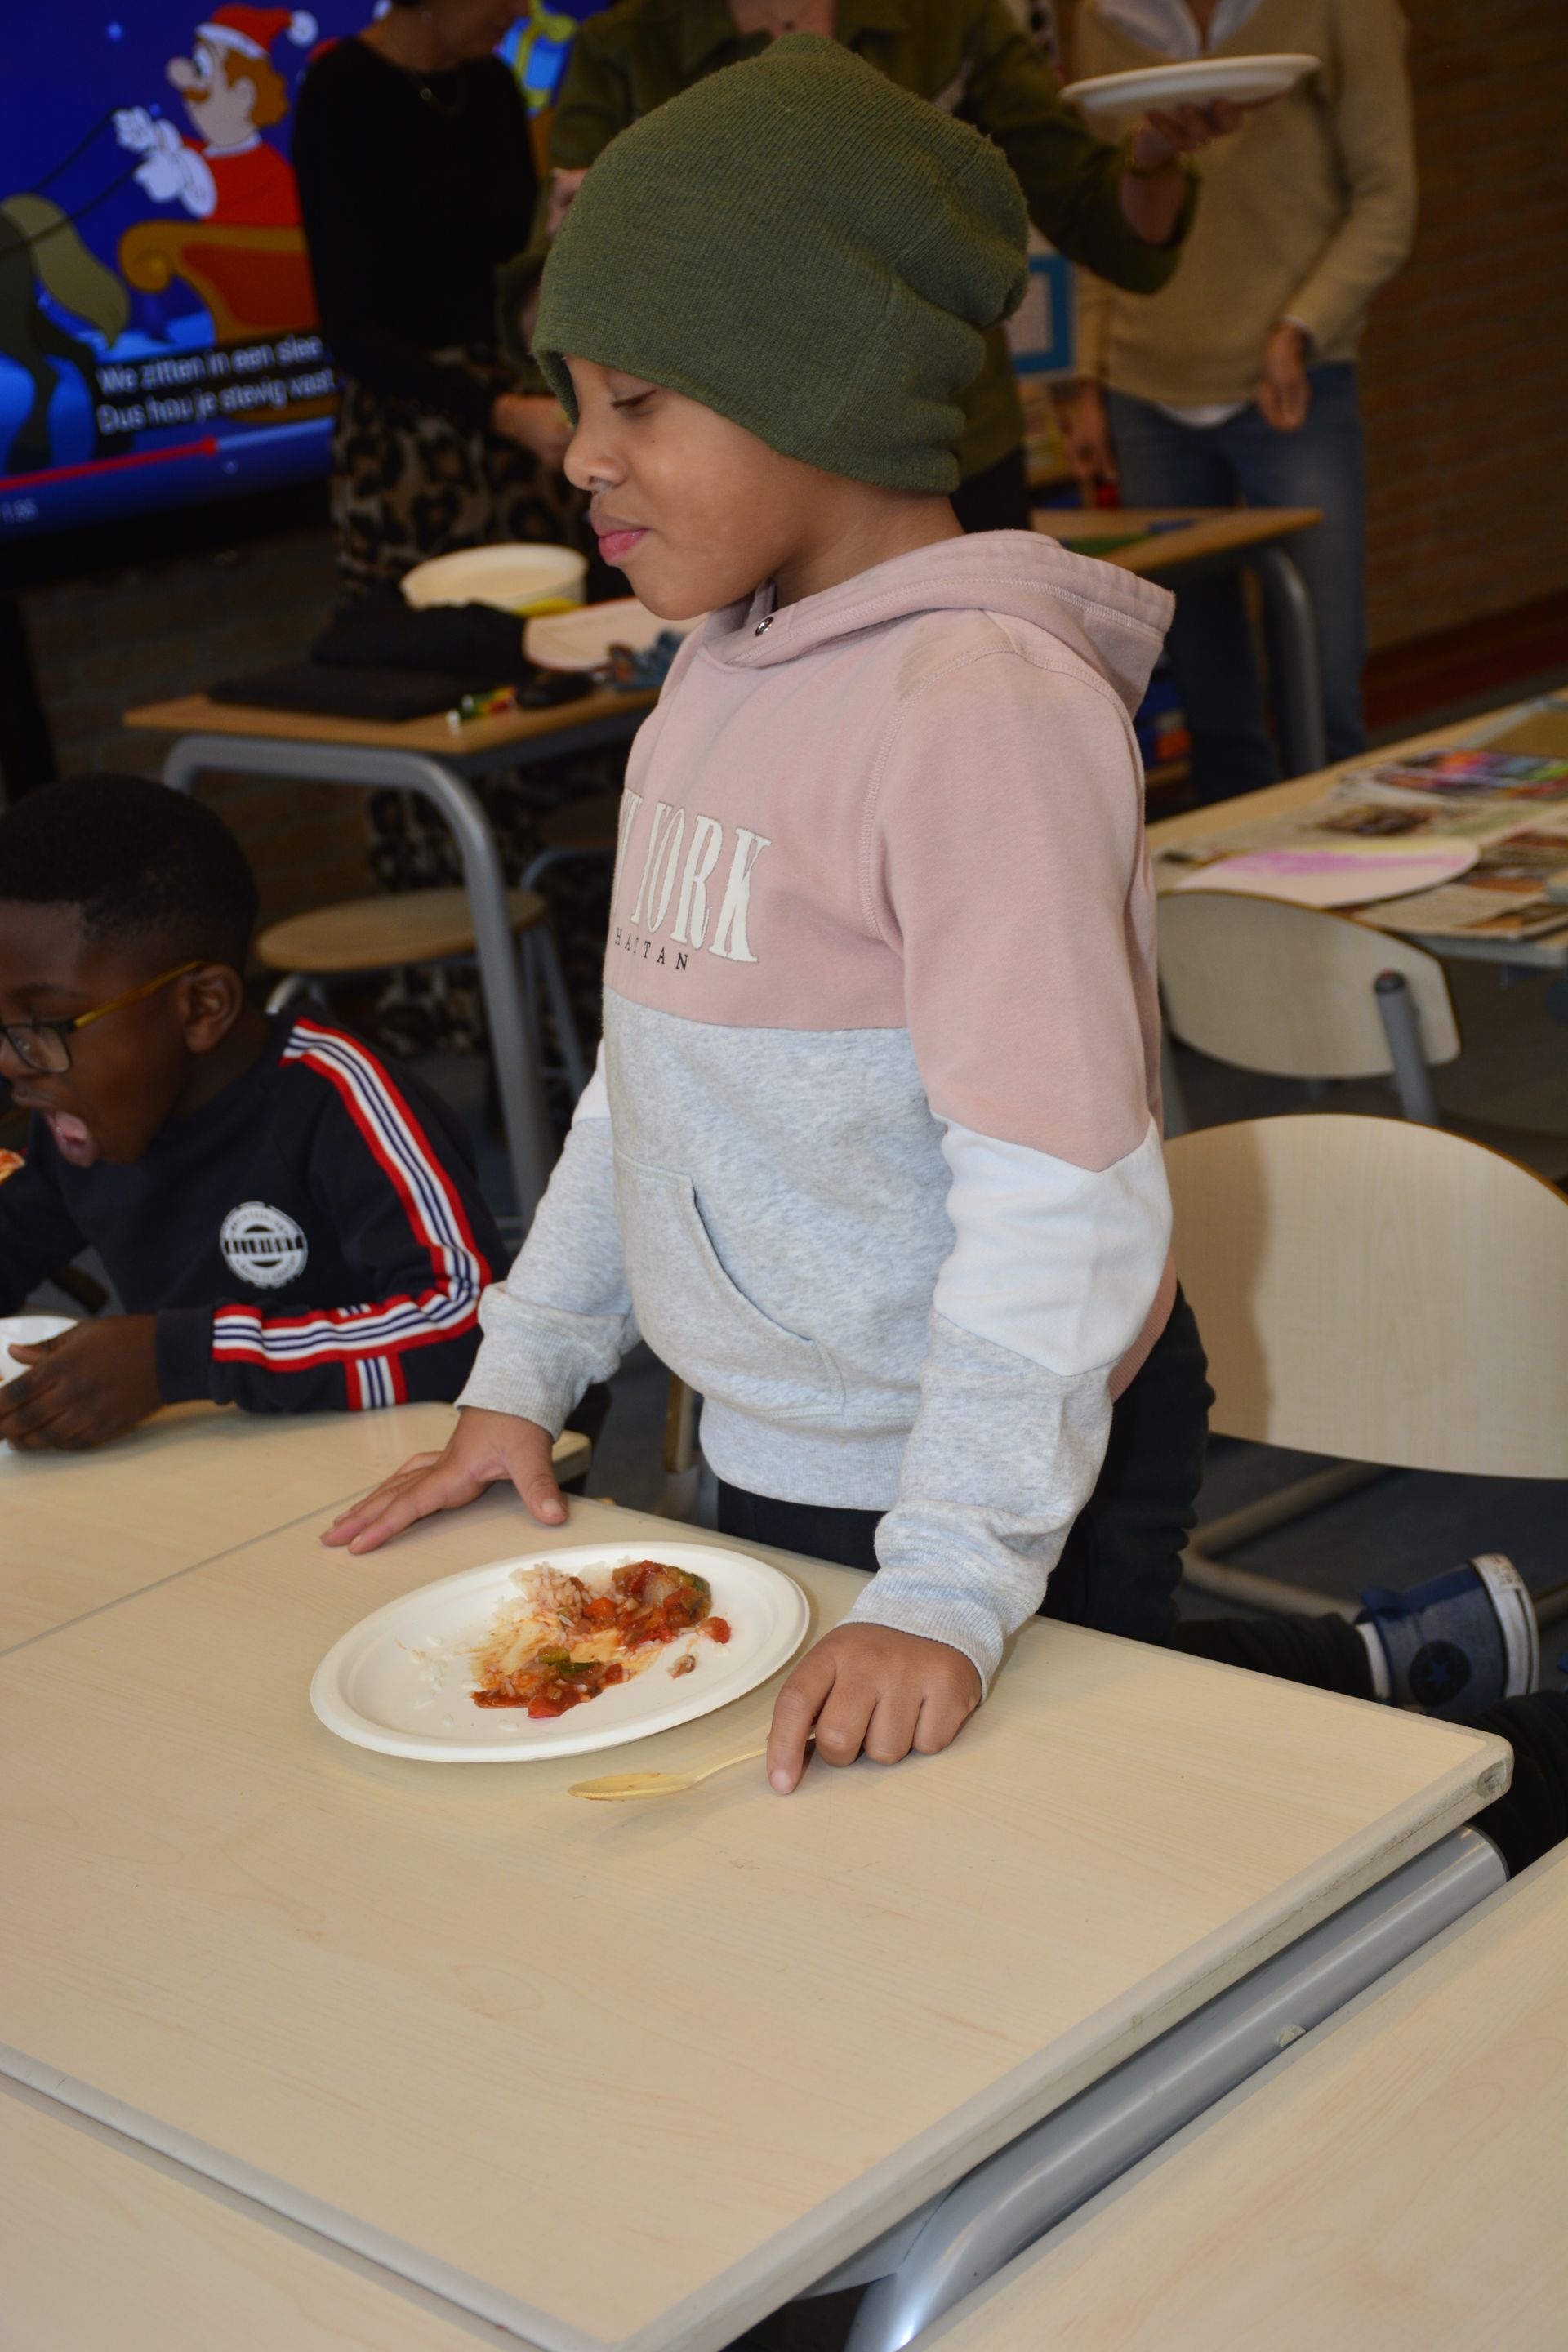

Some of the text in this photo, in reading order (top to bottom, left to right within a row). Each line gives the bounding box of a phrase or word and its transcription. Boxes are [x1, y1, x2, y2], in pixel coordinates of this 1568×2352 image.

[96, 335, 323, 395] We zitten in een slee
[96, 402, 147, 435] Dus
[145, 394, 193, 425] hou
[193, 388, 217, 423] je
[219, 376, 287, 410] stevig
[630, 800, 772, 963] YORK
[615, 927, 688, 971] HATAN
